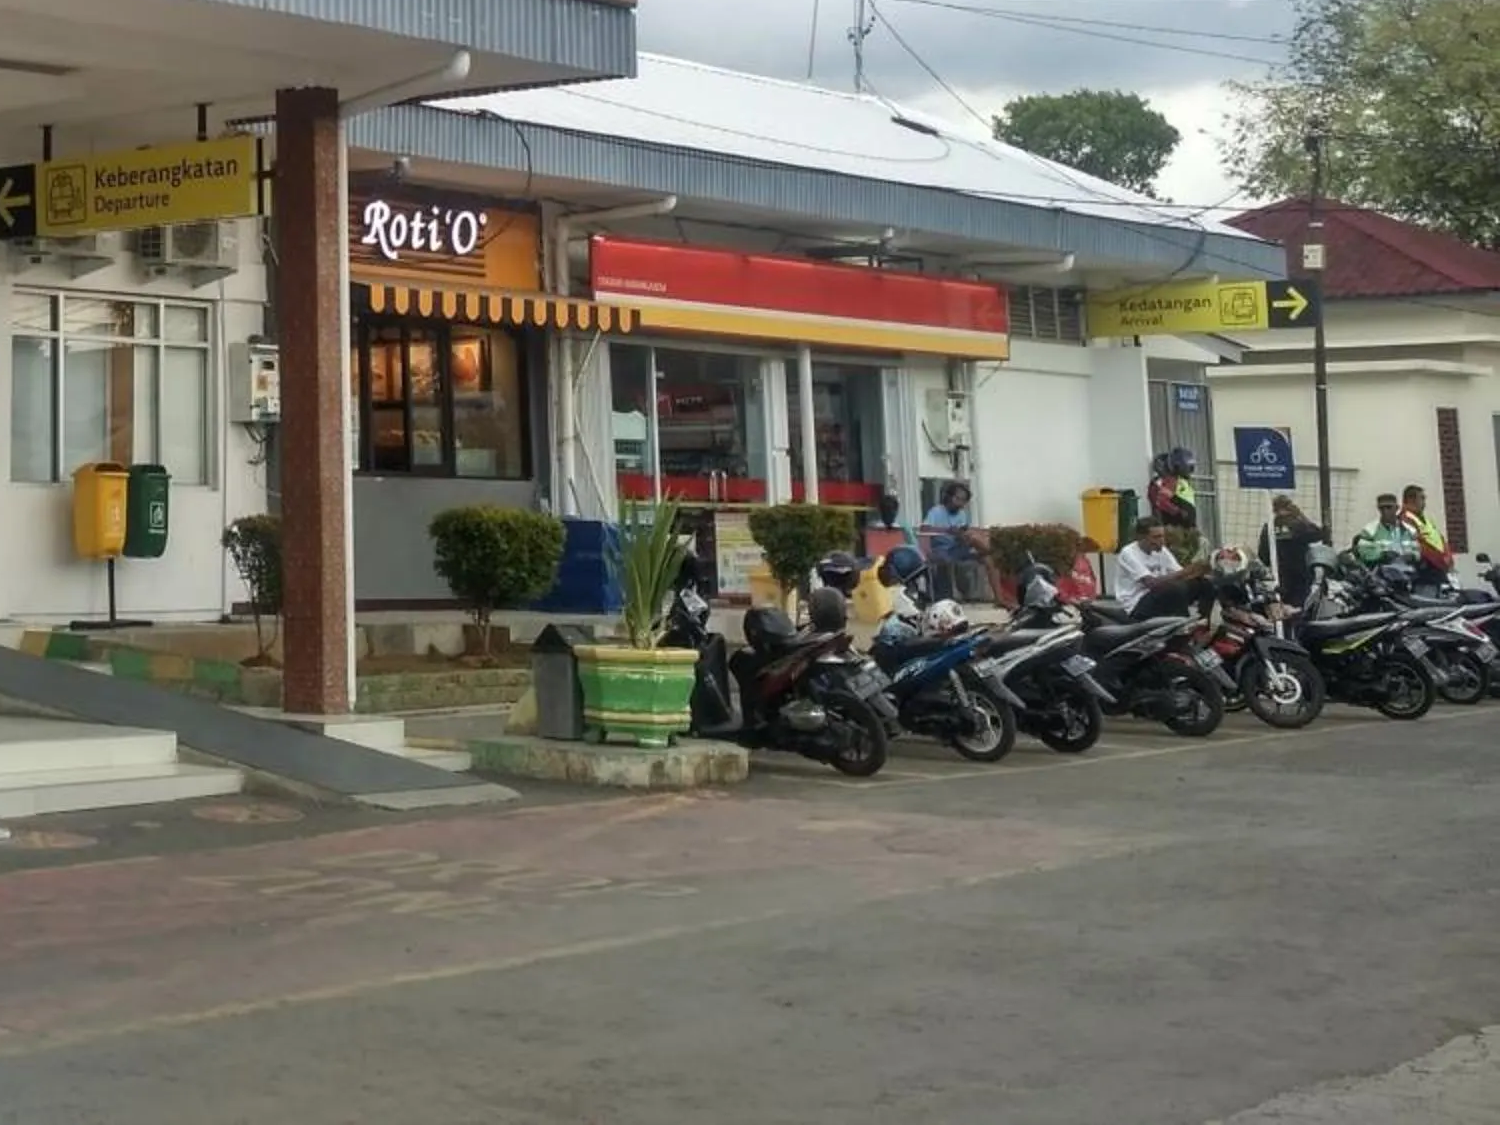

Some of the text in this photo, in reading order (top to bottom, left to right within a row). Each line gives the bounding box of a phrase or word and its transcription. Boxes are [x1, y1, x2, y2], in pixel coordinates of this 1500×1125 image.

[94, 158, 238, 188] Keberangkatan
[94, 192, 170, 215] Departure
[1119, 297, 1213, 313] Kedatangan
[1120, 314, 1164, 326] Arrival
